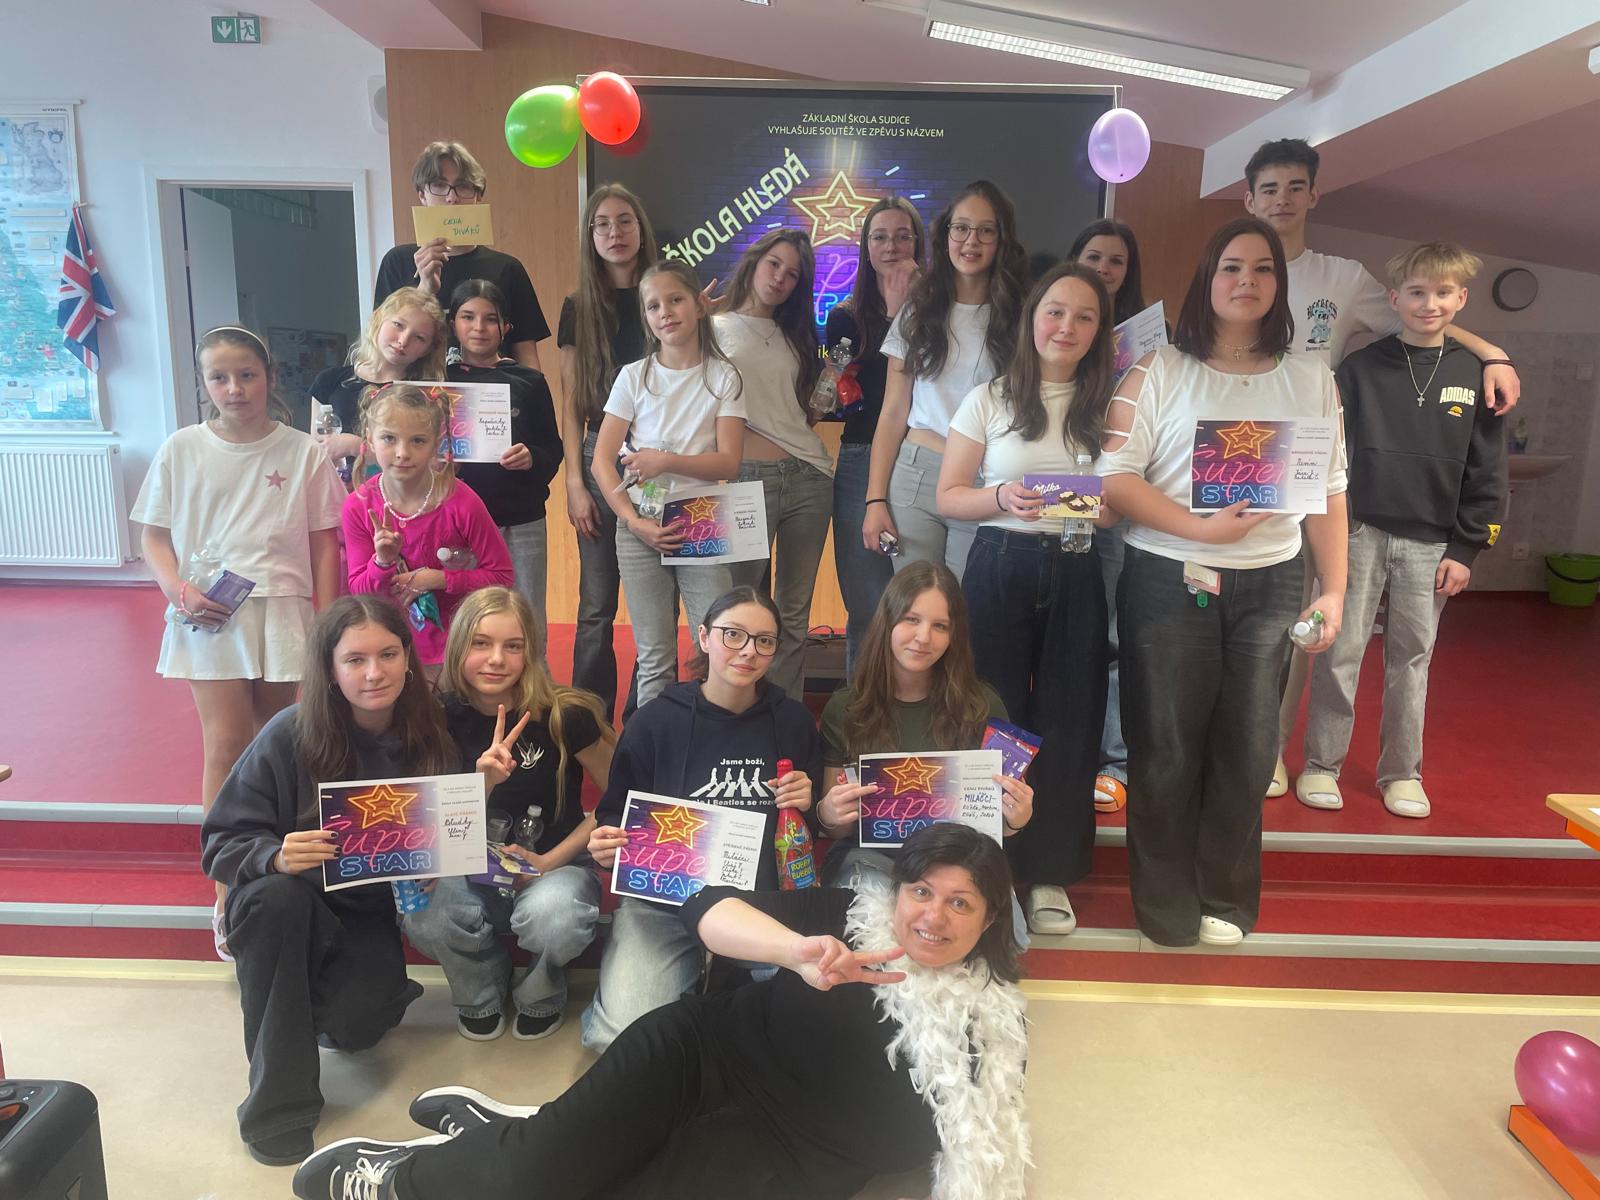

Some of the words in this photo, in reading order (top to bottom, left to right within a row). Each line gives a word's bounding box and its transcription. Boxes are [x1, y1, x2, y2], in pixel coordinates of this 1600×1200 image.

[802, 113, 847, 123] ZÁKLADNÍ
[848, 113, 877, 124] ŠKOLA
[879, 115, 910, 125] SUDICE
[768, 125, 818, 135] VYHLAŠUJE
[819, 126, 854, 136] SOUTĚŽ
[856, 127, 867, 135] VE
[869, 127, 898, 137] ZPĚVU
[899, 128, 905, 136] S
[906, 127, 944, 137] NÁZVEM
[733, 147, 810, 223] HLEDÁ
[1439, 386, 1476, 406] ADIDAS
[1032, 481, 1061, 496] Milka
[1201, 484, 1278, 504] STAR
[745, 757, 765, 766] boží,
[339, 850, 432, 878] STAR
